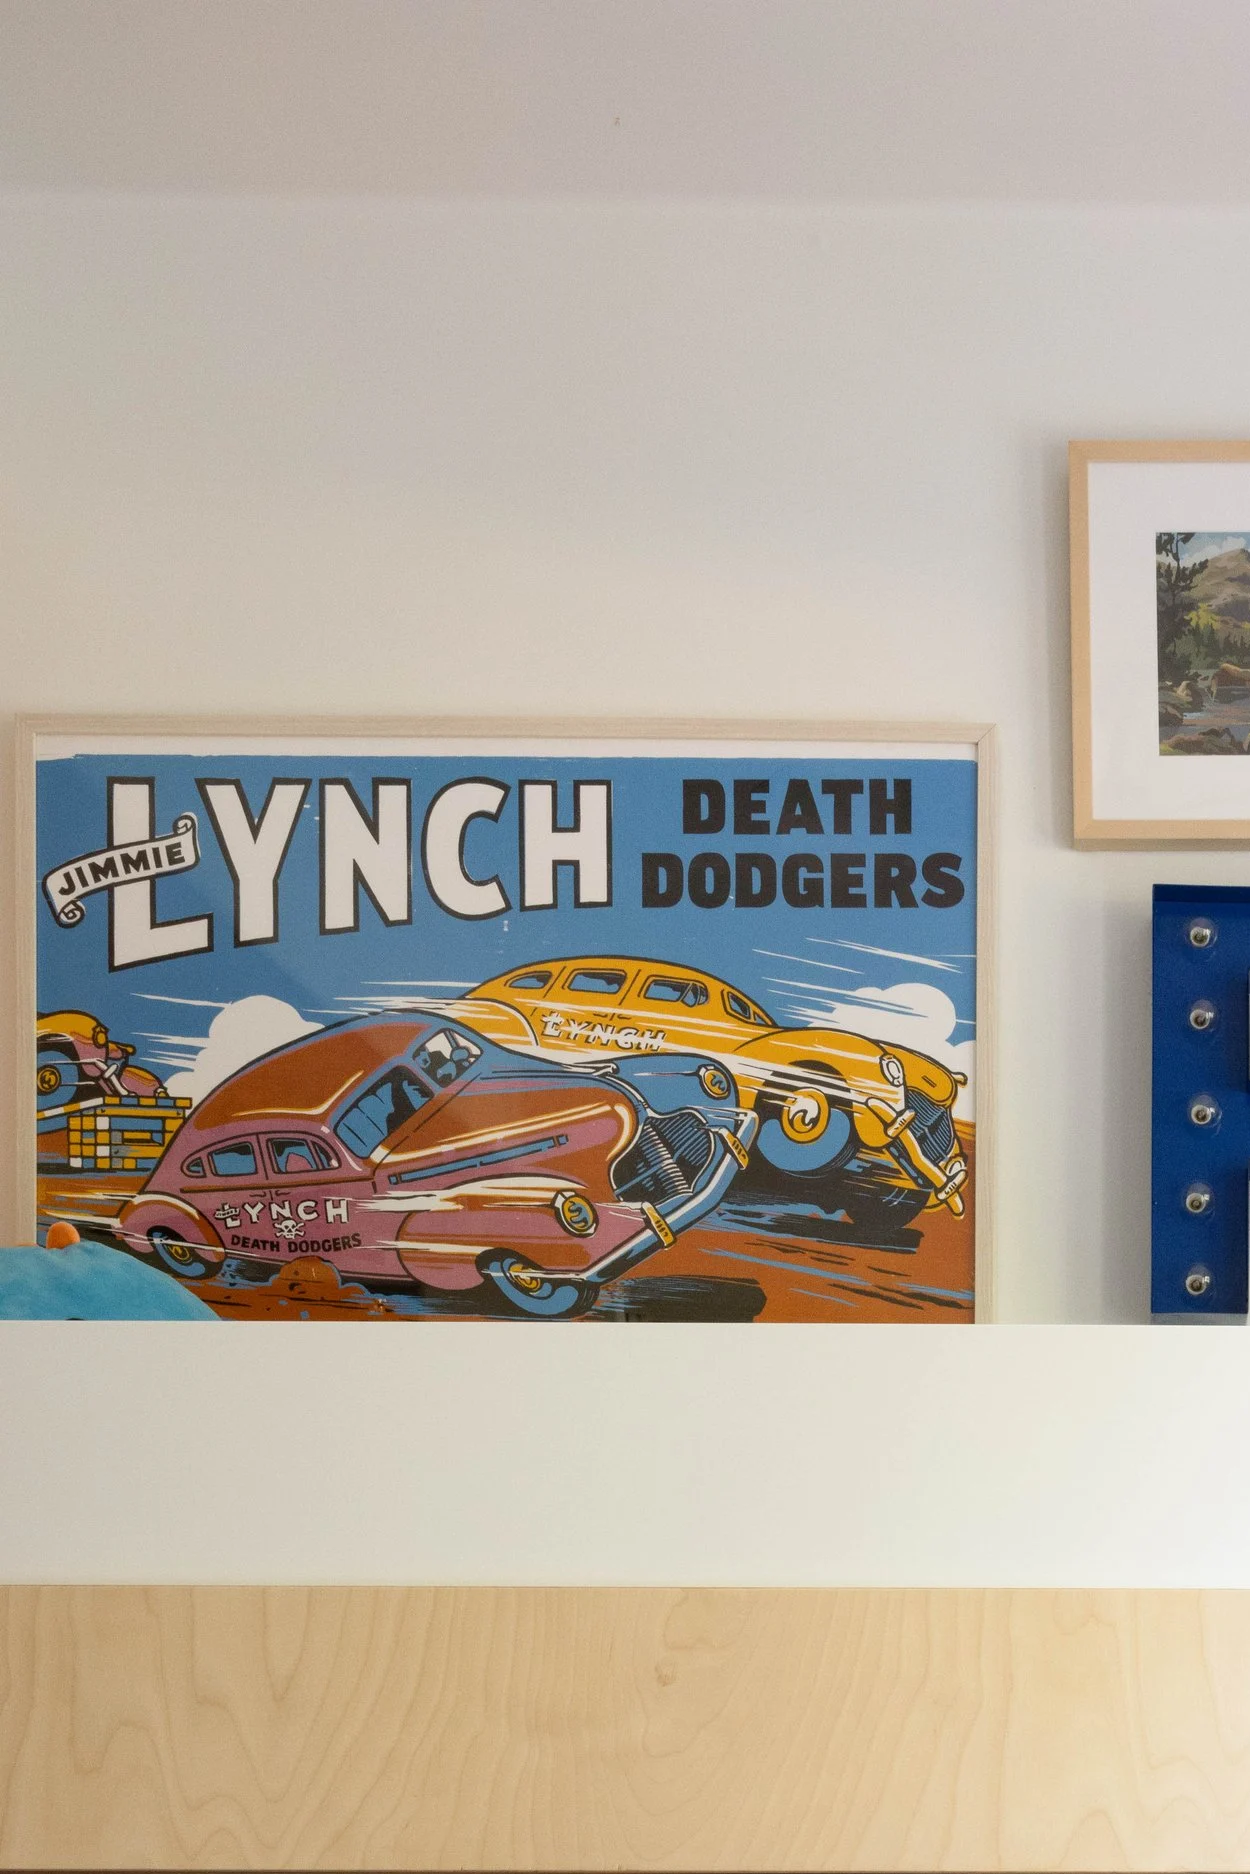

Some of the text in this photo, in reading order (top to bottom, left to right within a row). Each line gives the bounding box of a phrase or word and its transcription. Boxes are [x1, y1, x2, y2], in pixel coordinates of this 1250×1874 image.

[682, 777, 914, 836] DEATH
[58, 838, 188, 898] JIMMIE
[106, 775, 613, 972] LYNCH
[640, 850, 966, 910] DODGERS
[541, 1010, 666, 1052] LYNCH
[222, 1199, 350, 1229] LYNCH
[231, 1232, 362, 1253] DEATH DODGERS
